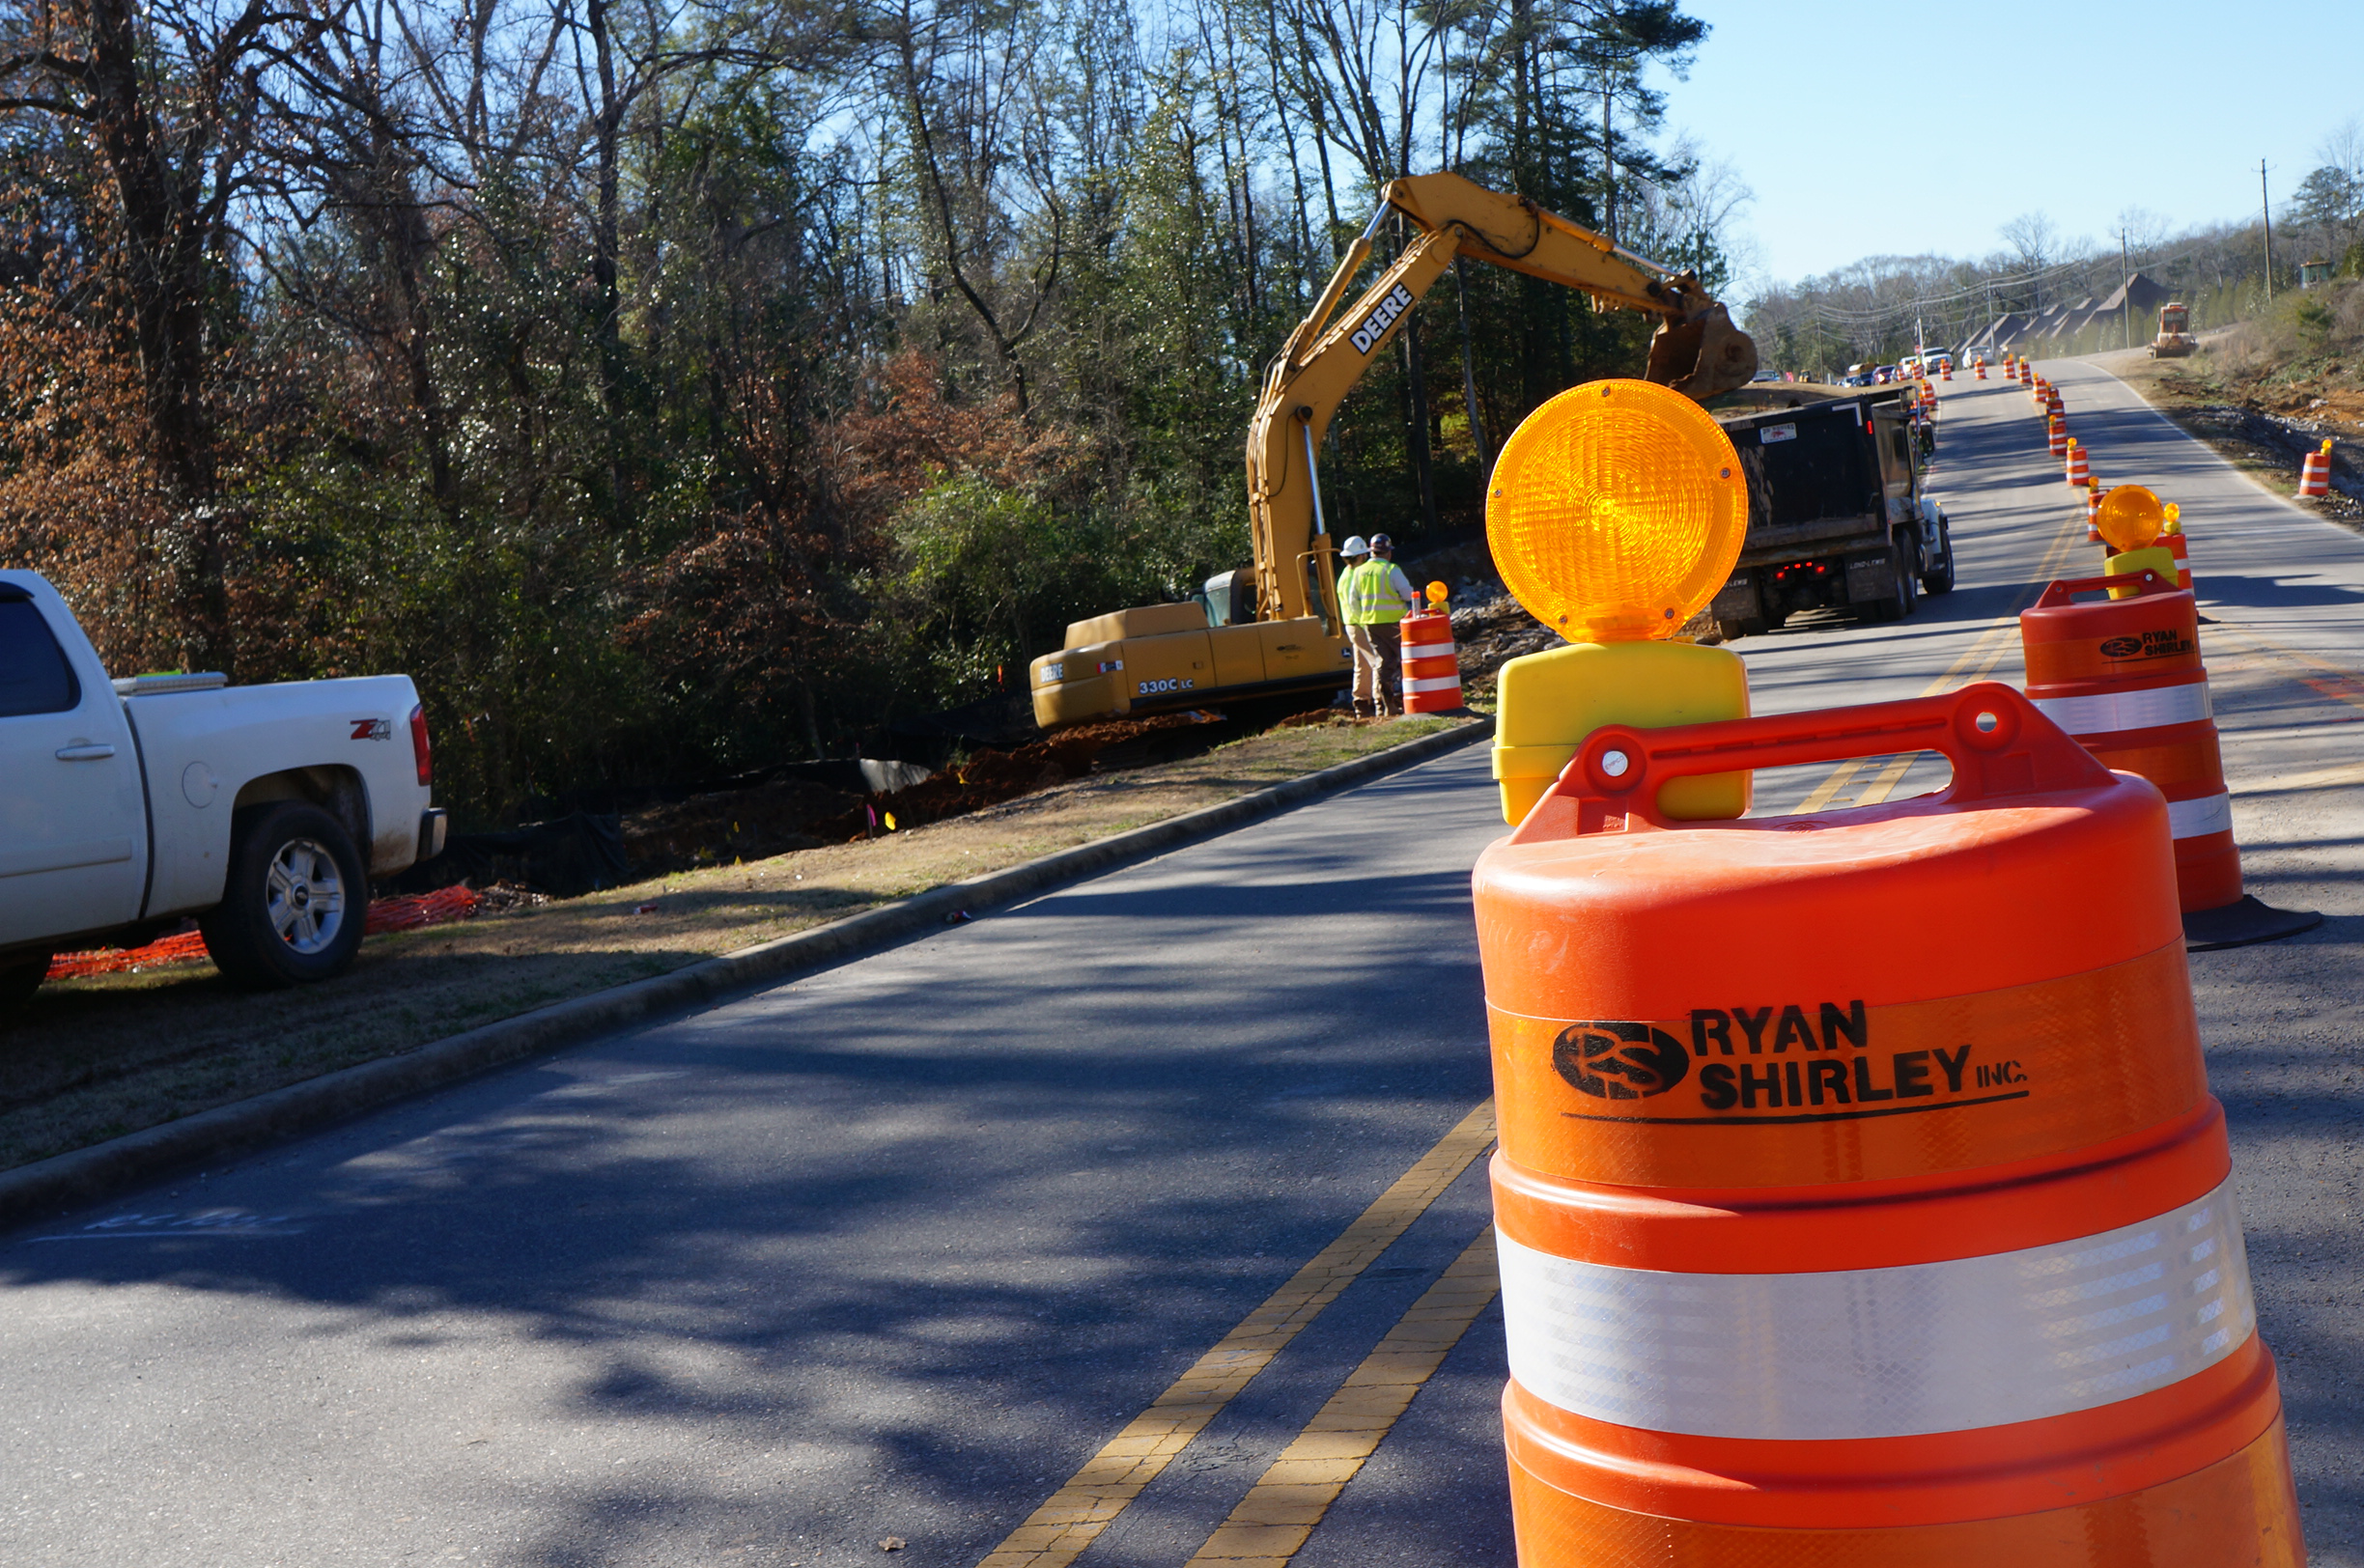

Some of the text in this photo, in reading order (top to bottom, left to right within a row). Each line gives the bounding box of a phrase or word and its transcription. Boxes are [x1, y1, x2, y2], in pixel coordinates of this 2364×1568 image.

[1350, 282, 1413, 354] DEERE
[2142, 630, 2177, 644] RYAN
[1041, 663, 1063, 683] DEERE
[1139, 678, 1194, 694] 330C LC
[1690, 1000, 1868, 1055] RYAN
[1699, 1044, 1972, 1110] SHIRLEY
